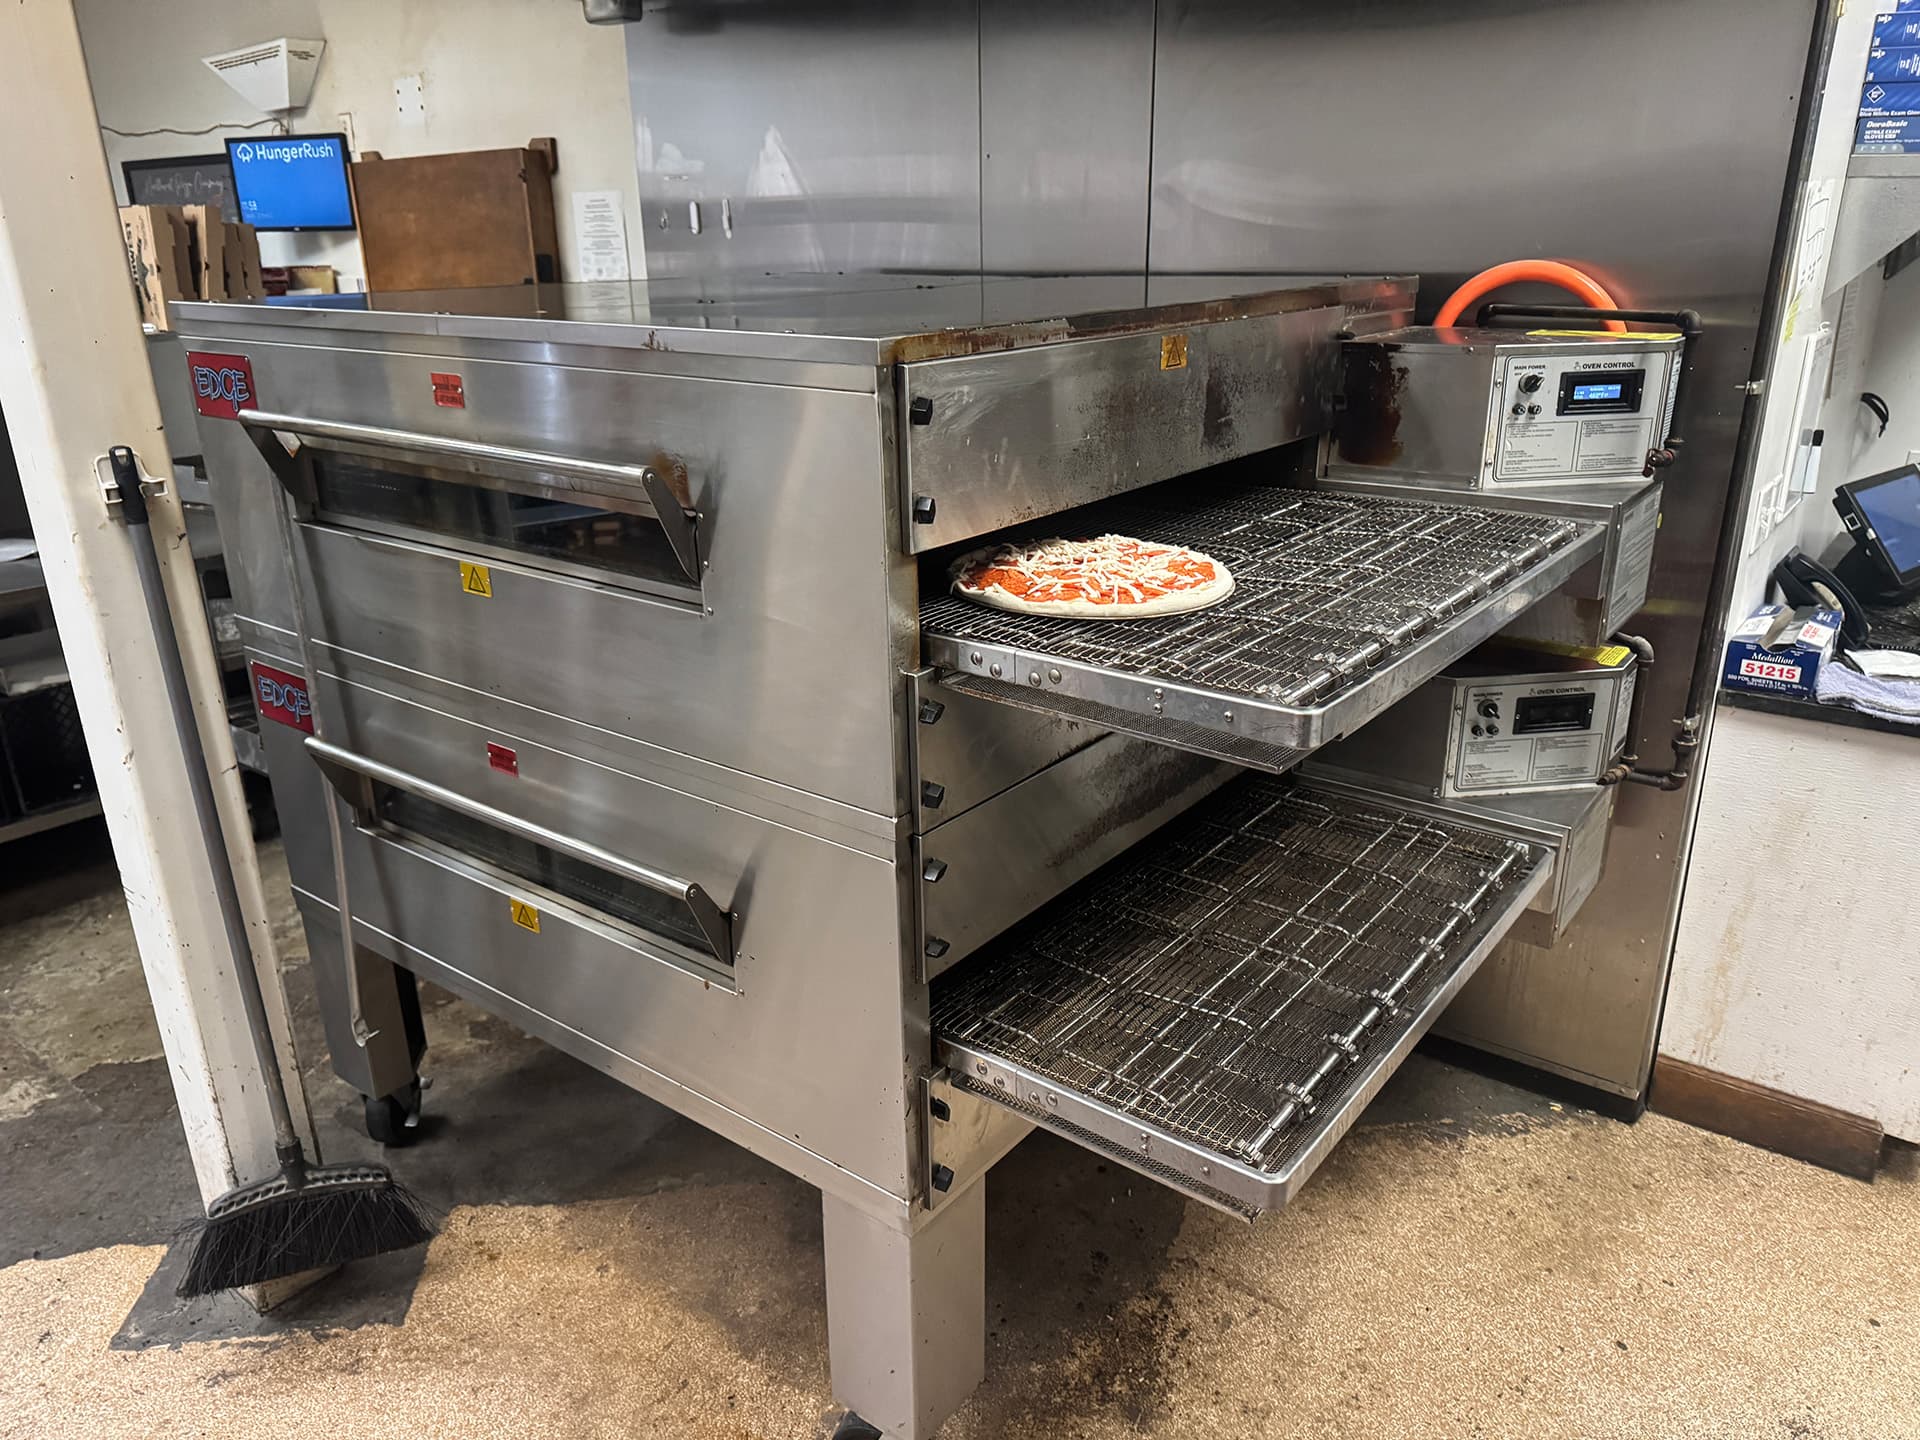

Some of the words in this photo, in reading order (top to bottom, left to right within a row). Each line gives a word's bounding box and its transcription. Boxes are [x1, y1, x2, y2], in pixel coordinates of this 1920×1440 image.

[255, 142, 334, 163] HungerRush
[1603, 361, 1635, 369] CONTROL
[193, 365, 250, 412] EDGE
[1751, 652, 1795, 665] Medallion
[1745, 662, 1796, 680] 51215
[257, 674, 311, 723] EDGE
